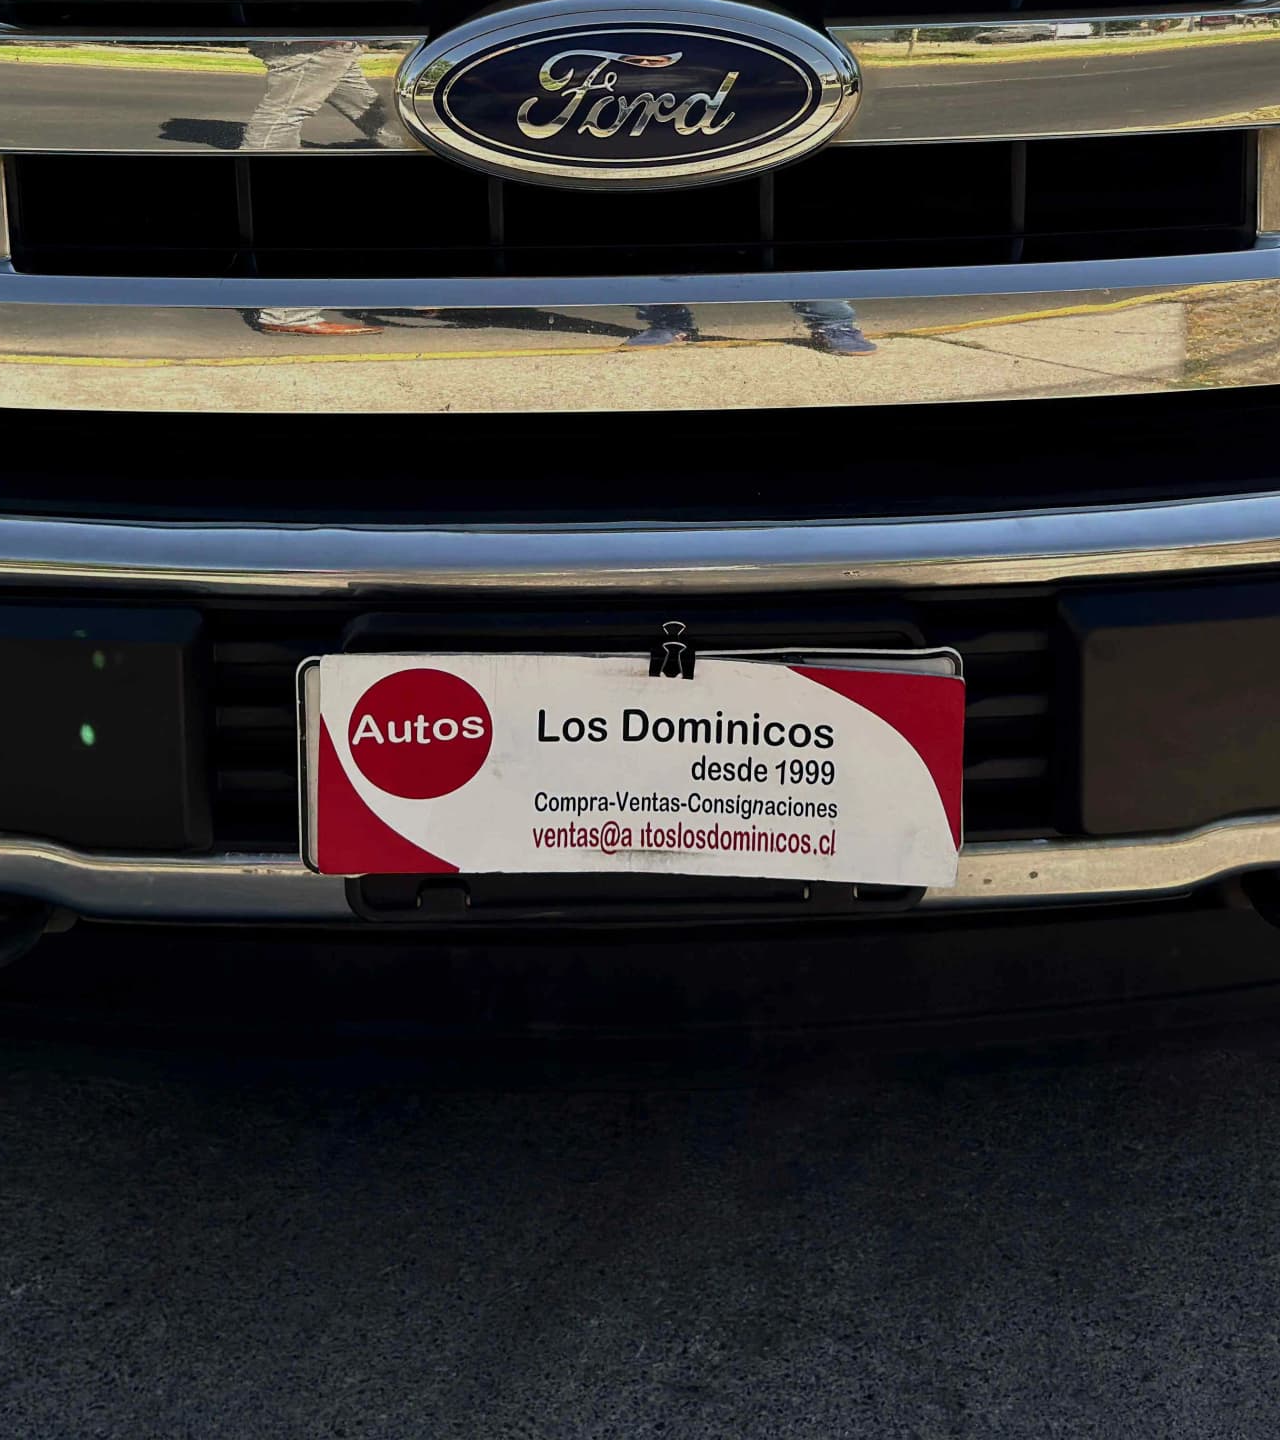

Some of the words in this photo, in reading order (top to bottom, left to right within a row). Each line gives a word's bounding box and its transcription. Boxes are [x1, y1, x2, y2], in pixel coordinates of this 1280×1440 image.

[516, 49, 739, 140] Ford
[351, 714, 485, 746] Autos
[537, 709, 608, 743] Los
[622, 708, 835, 749] Dominicos
[690, 755, 768, 783] desde
[774, 759, 836, 785] 1999
[534, 791, 838, 820] Compra-Ventas-Consignaciones
